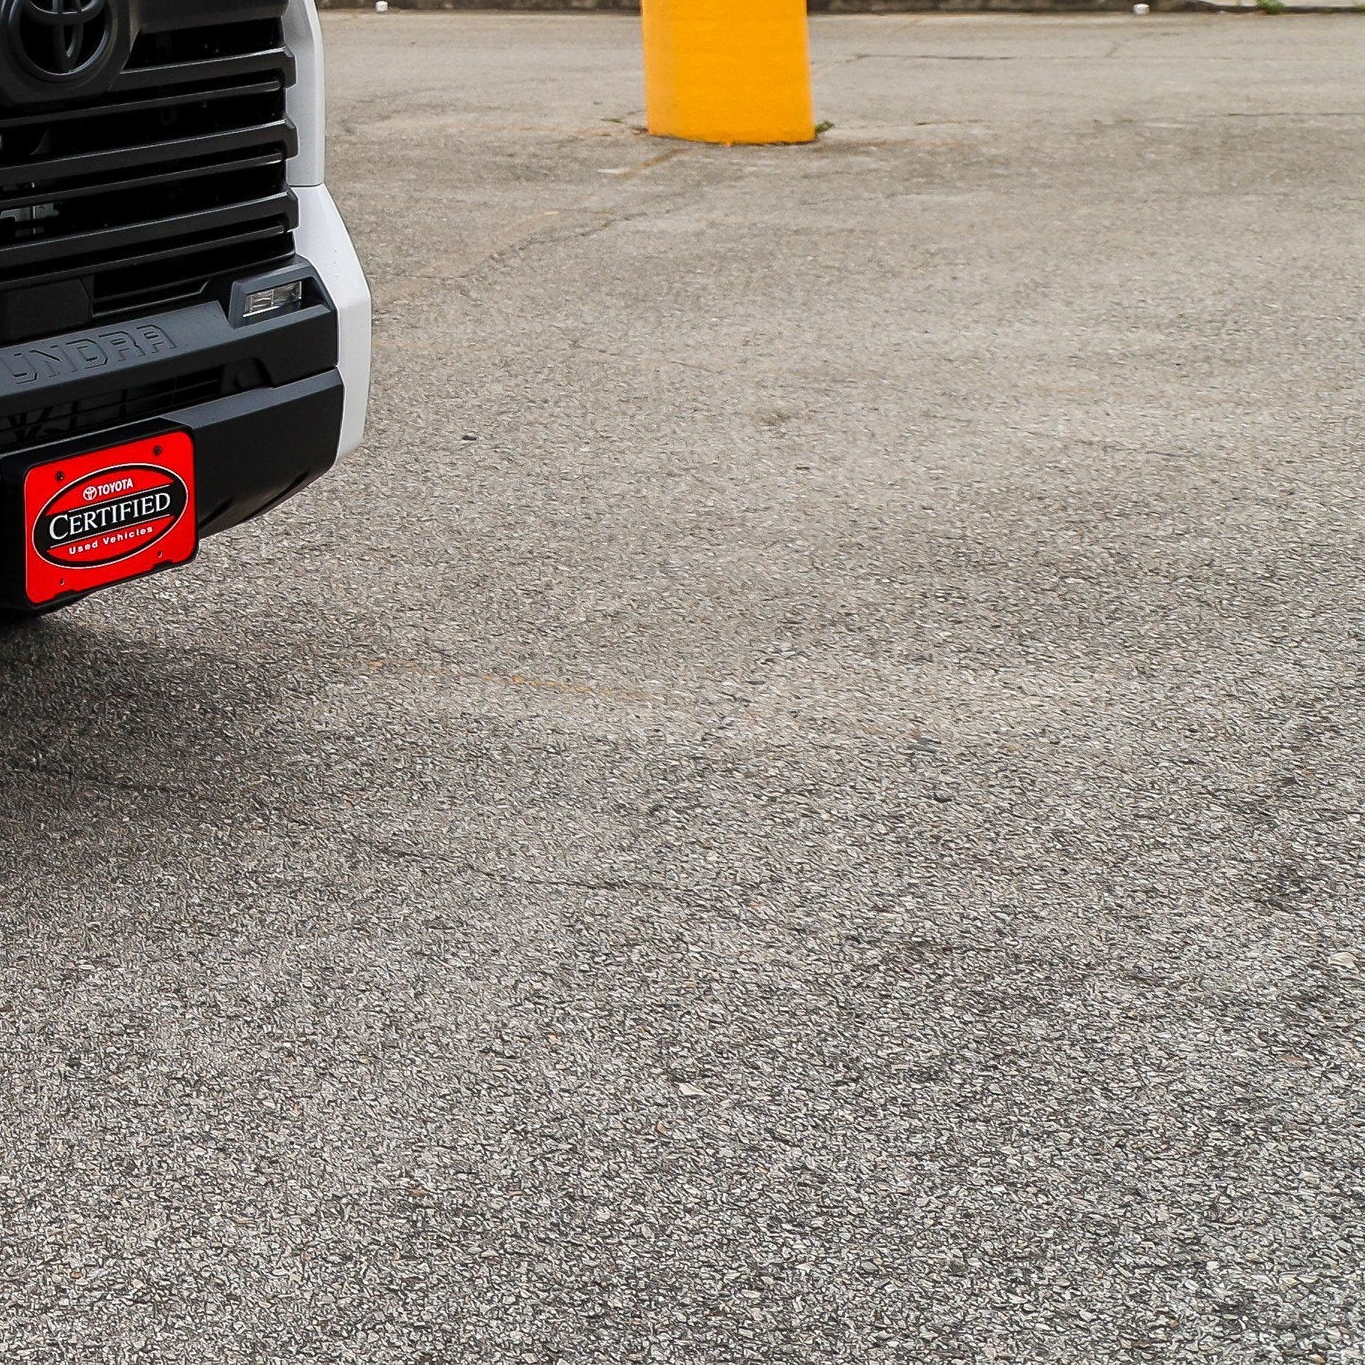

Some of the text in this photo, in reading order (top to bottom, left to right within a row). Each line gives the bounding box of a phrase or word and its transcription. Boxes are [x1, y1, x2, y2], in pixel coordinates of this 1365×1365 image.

[98, 477, 134, 497] TOYOTA
[49, 492, 171, 540] CERTIFIED
[69, 525, 154, 555] Used Vehicles
